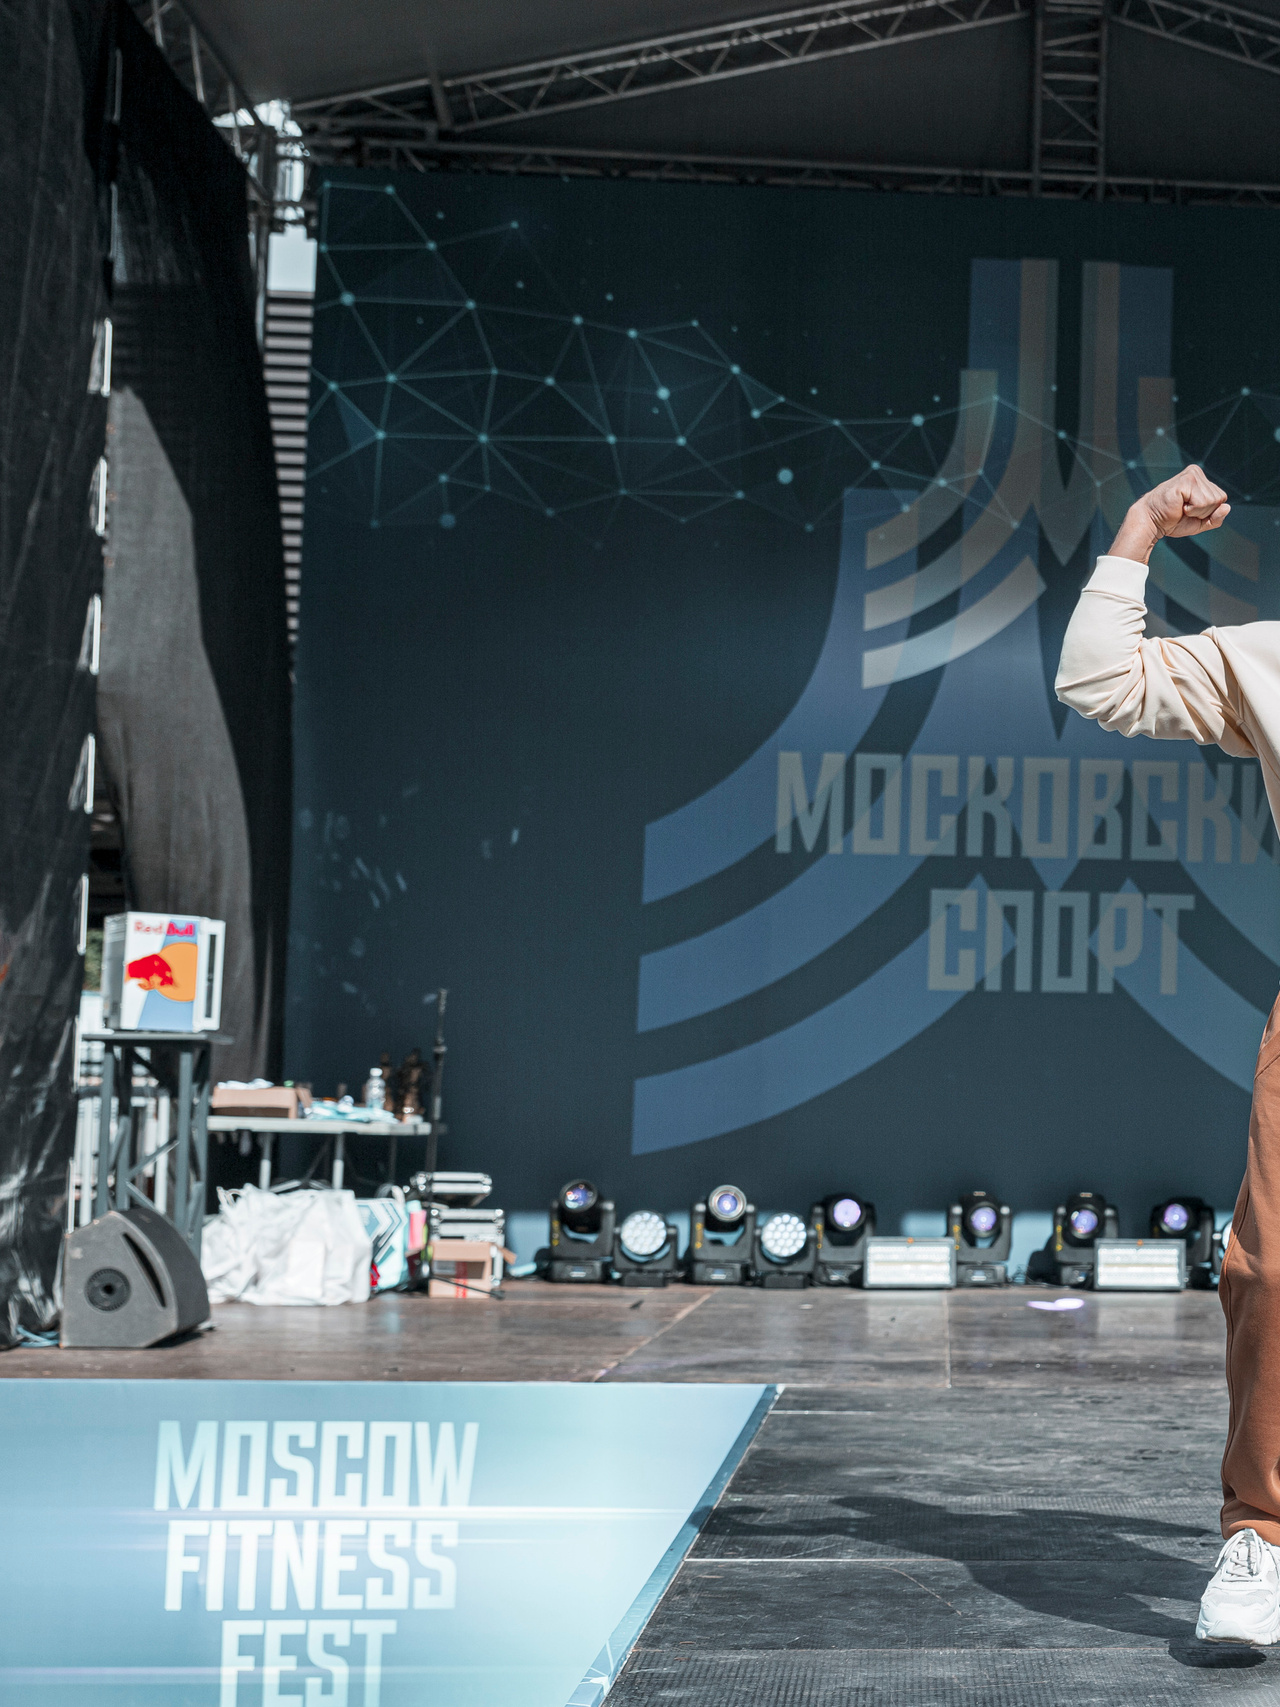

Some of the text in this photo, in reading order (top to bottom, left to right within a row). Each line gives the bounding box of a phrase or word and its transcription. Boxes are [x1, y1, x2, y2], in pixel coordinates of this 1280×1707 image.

[927, 888, 1195, 995] СПОРТ
[154, 1420, 479, 1511] MOSCOW
[164, 1519, 459, 1611] FITNESS
[219, 1618, 398, 1707] FEST
